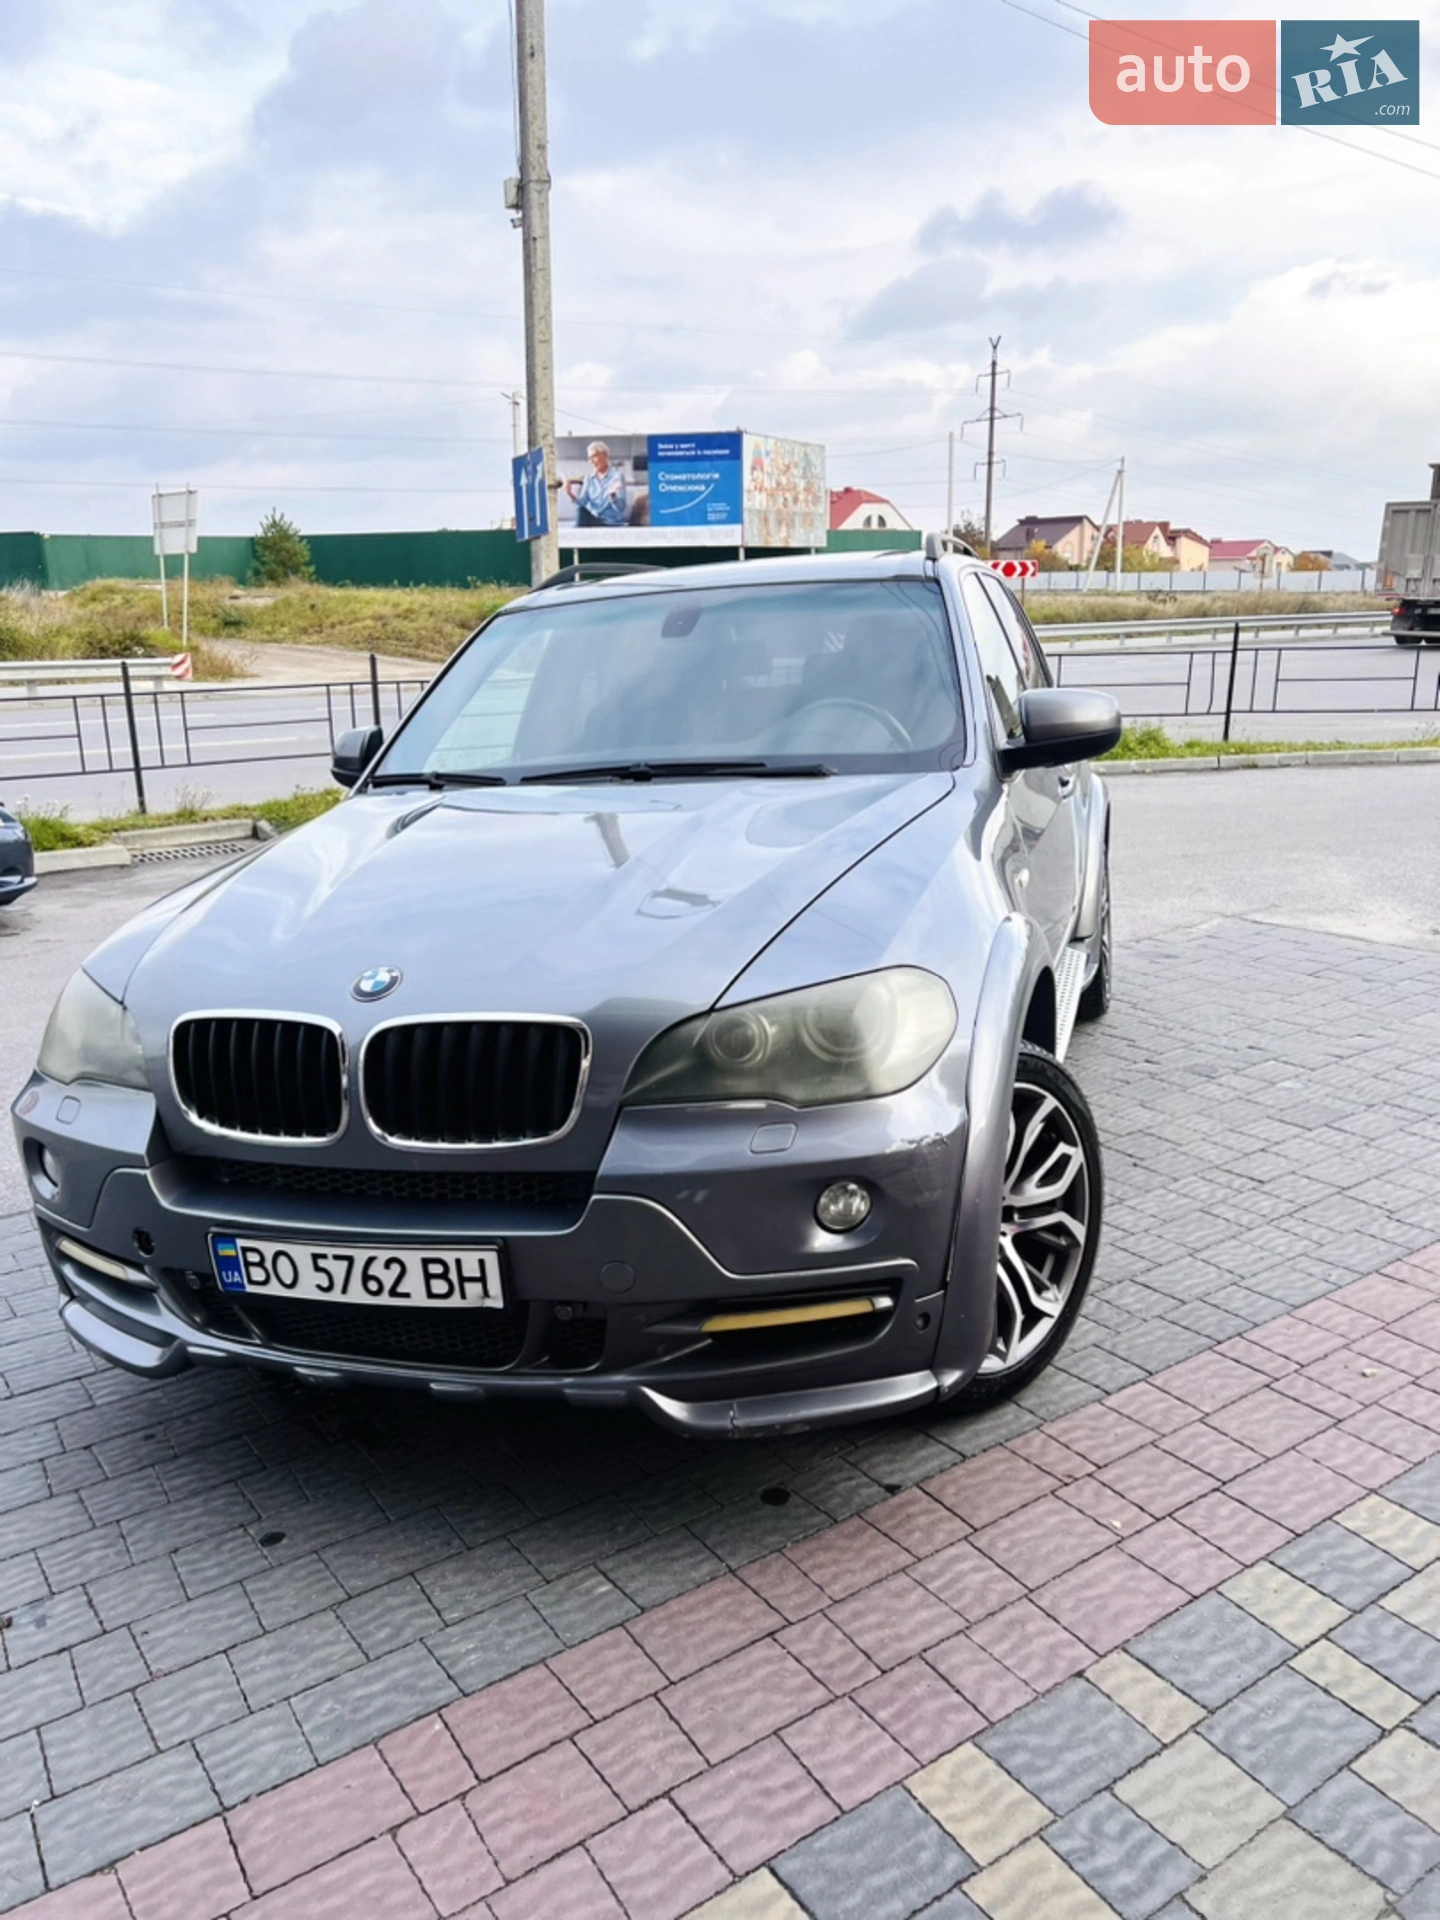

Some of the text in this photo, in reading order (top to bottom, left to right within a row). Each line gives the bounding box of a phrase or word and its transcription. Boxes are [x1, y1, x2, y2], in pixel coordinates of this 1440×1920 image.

[658, 471, 720, 481] Стоматологія
[221, 1246, 492, 1301] UA BO 5762 BH
